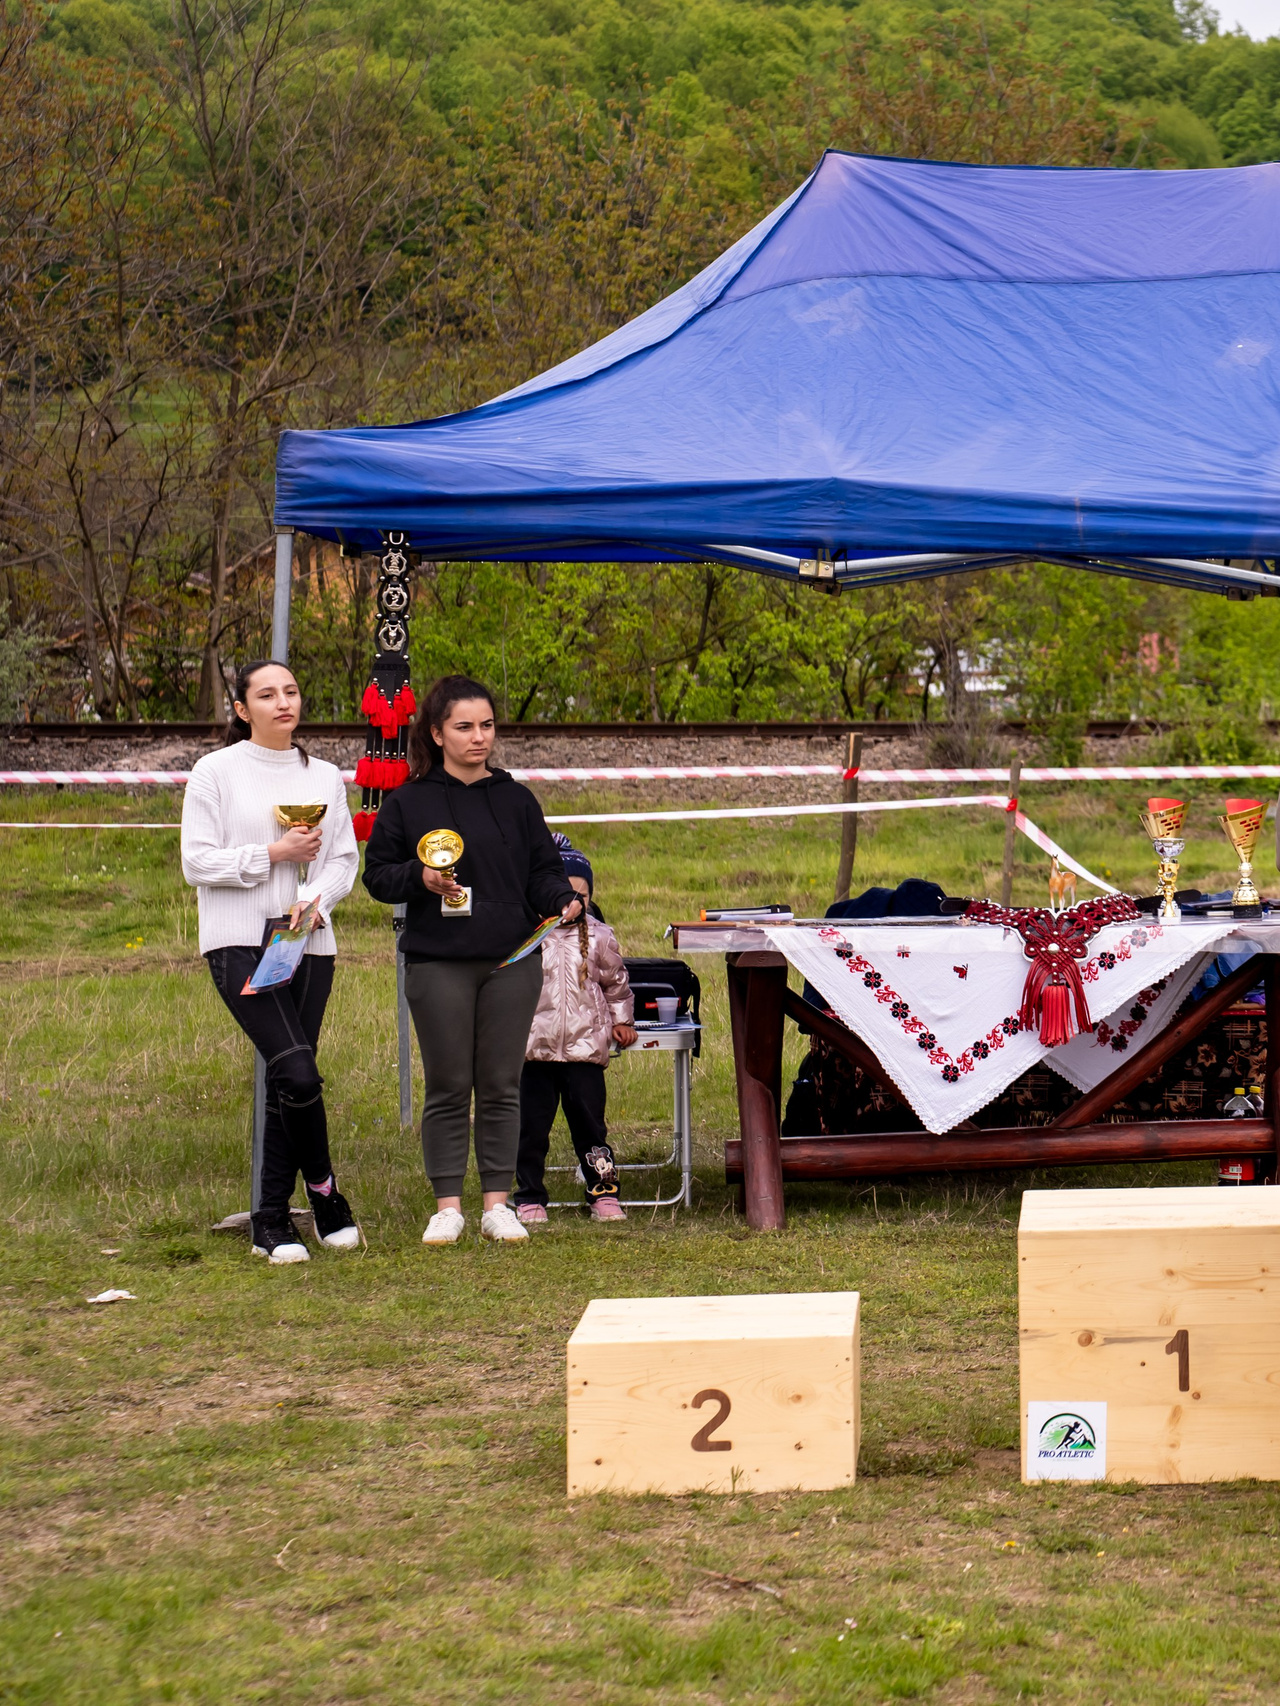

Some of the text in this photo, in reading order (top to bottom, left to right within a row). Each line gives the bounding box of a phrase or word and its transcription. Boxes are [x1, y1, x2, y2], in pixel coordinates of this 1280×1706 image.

[1166, 1329, 1190, 1392] 1
[691, 1389, 732, 1452] 2
[1037, 1450, 1094, 1458] PRO ATLETIC
